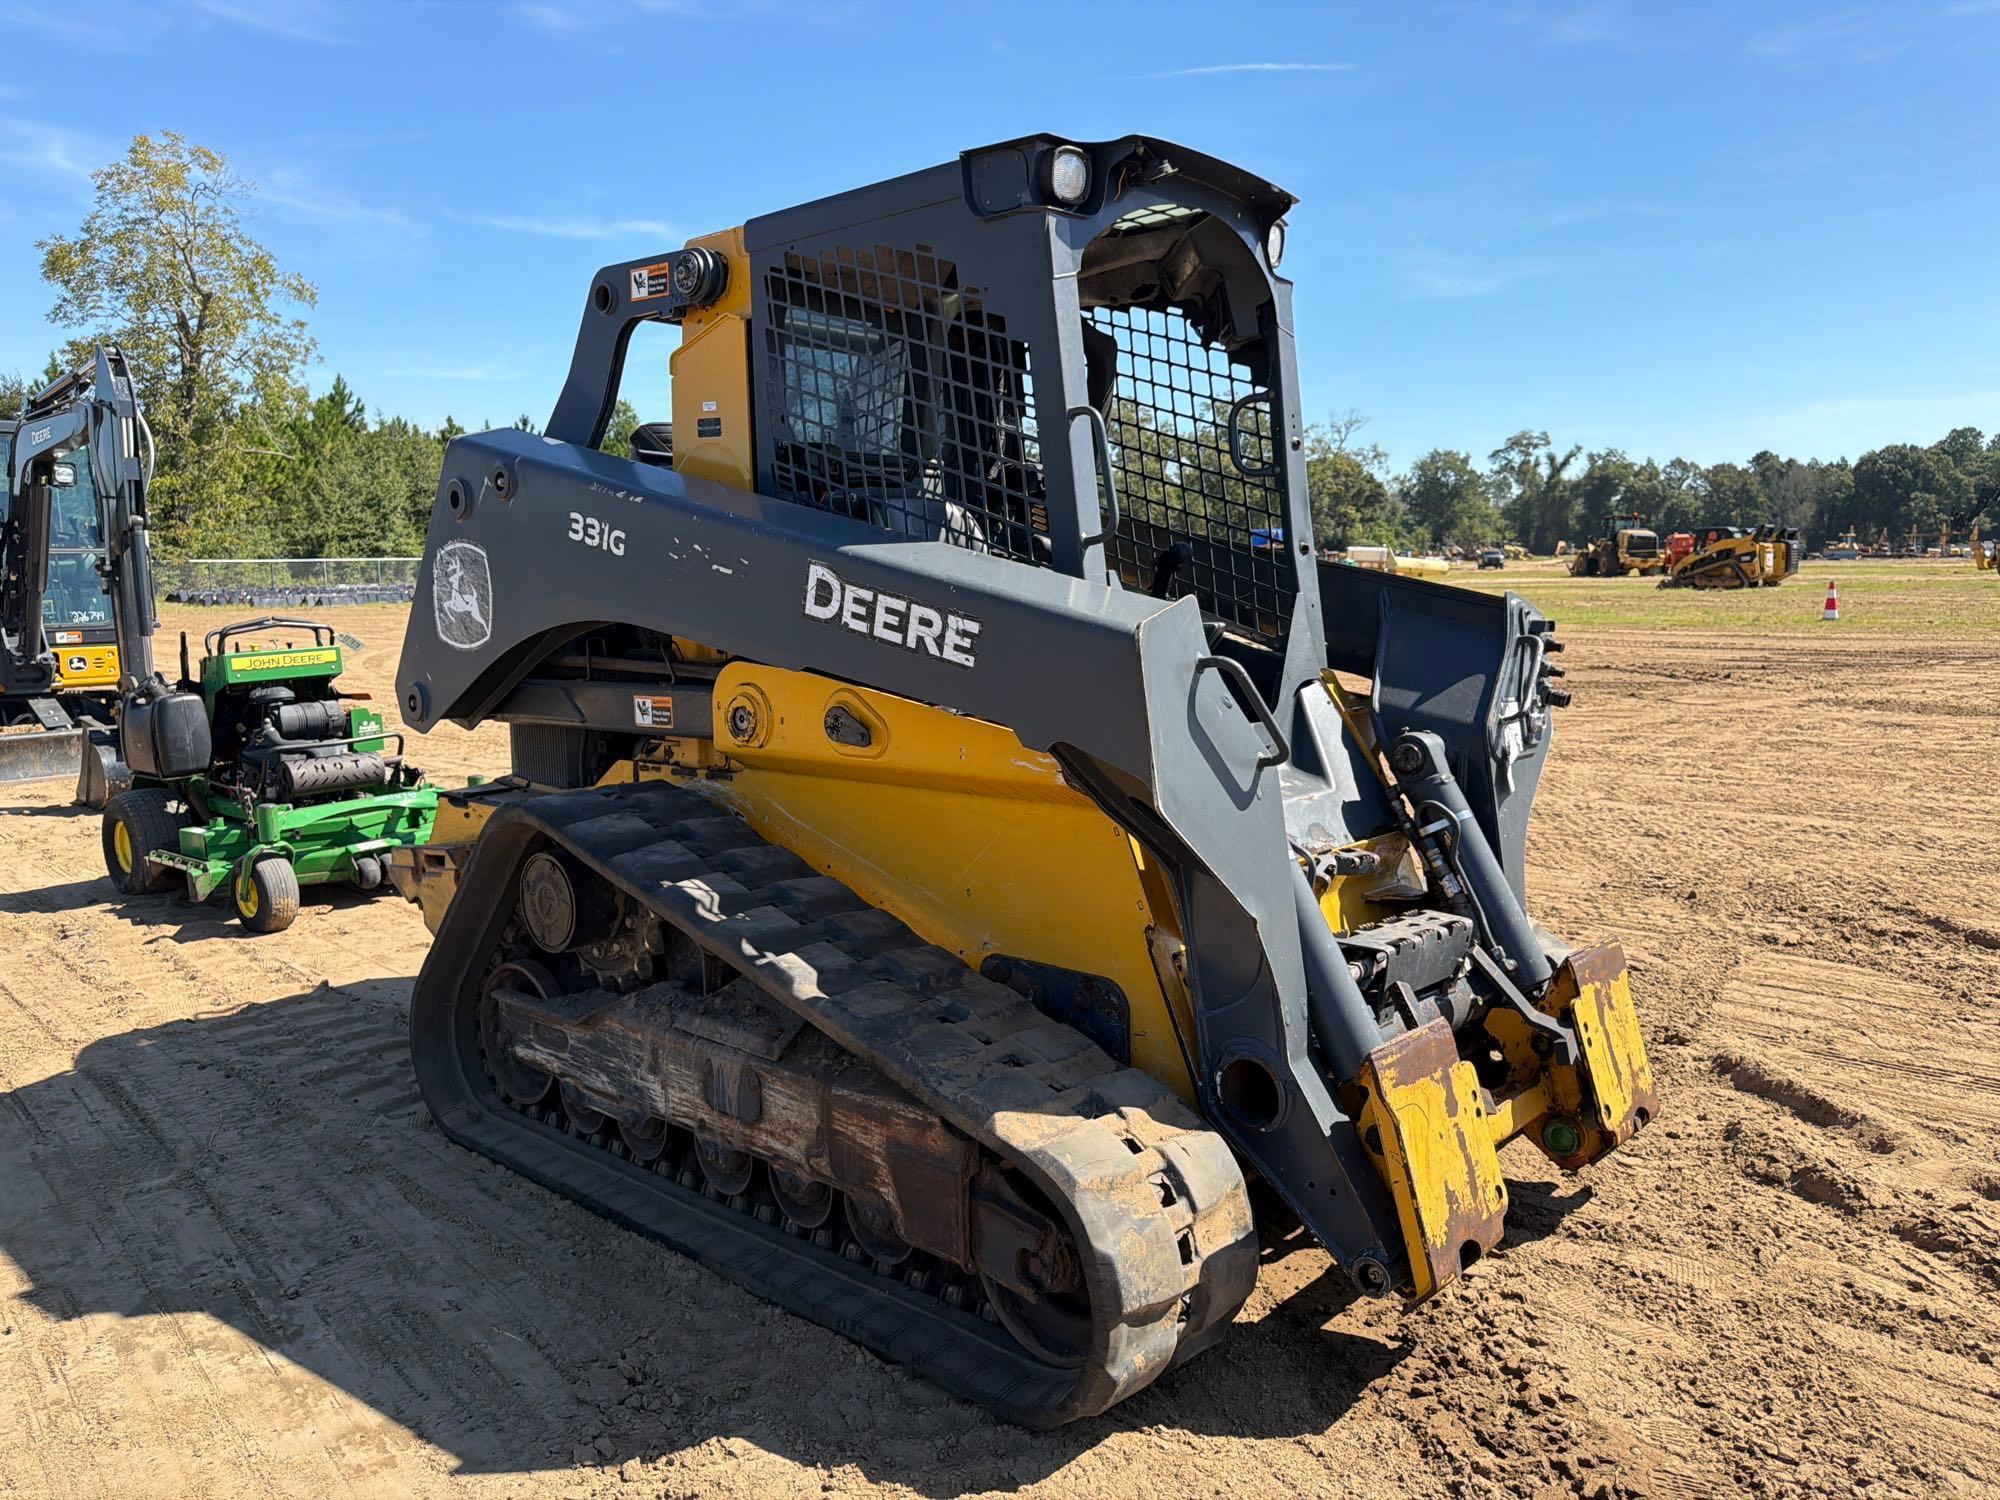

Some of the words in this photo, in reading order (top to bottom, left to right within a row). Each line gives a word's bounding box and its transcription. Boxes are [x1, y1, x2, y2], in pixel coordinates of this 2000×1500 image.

[31, 425, 52, 446] DEERE
[568, 511, 626, 556] 331G
[804, 563, 980, 668] DEERE
[247, 656, 280, 669] JOHN
[282, 653, 324, 665] DEERE
[314, 759, 361, 773] HOT
